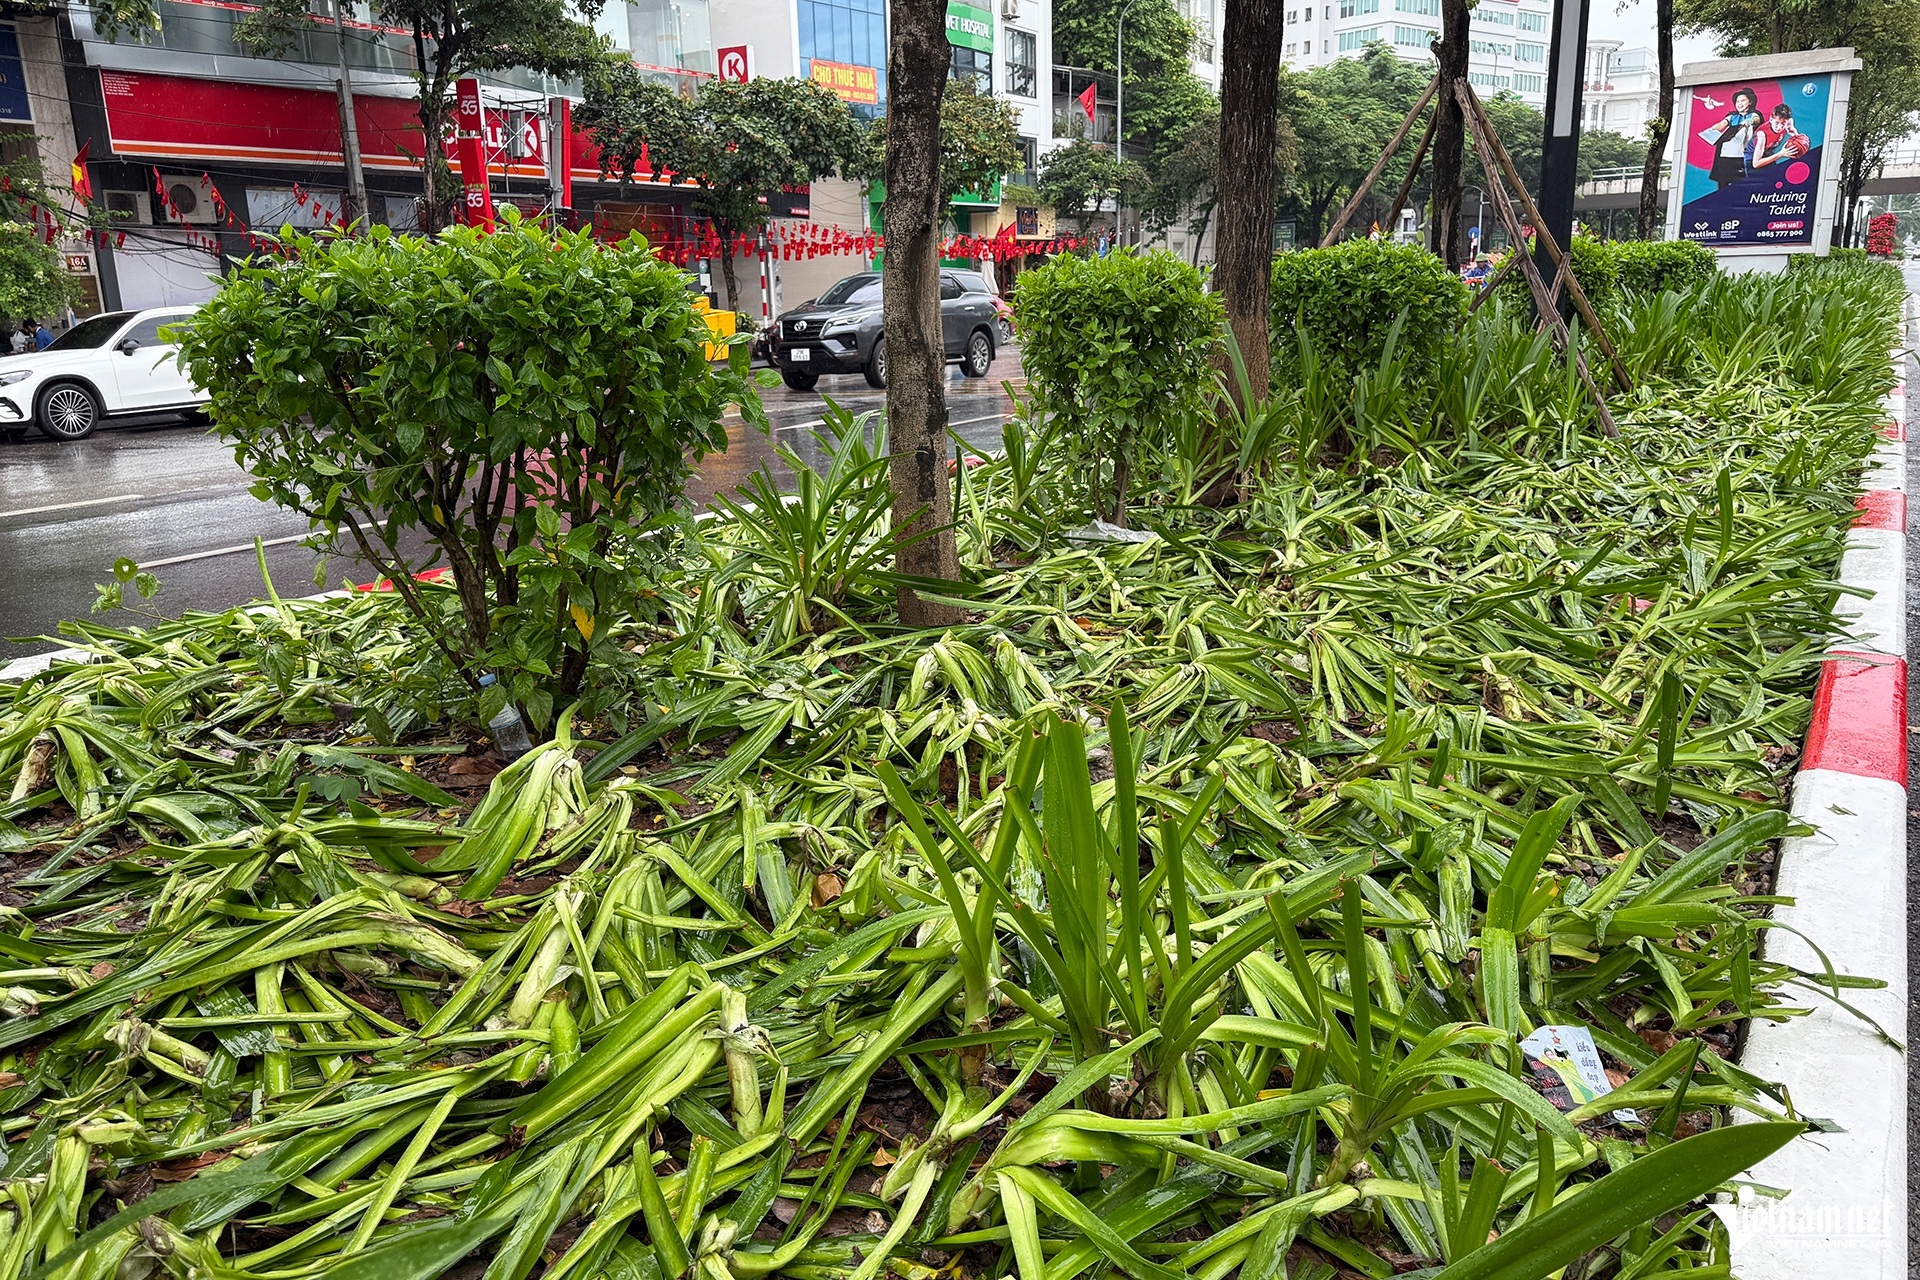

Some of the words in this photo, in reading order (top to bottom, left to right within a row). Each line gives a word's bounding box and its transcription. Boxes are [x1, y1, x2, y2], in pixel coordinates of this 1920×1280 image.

[961, 17, 990, 39] HOSPITAL
[813, 65, 831, 83] CHO
[833, 66, 855, 87] THUÊ
[460, 100, 478, 115] 5G
[467, 193, 484, 207] 5G
[1749, 191, 1808, 204] Nurturing
[1769, 204, 1807, 216] Talent
[1756, 230, 1775, 238] 0865
[70, 257, 87, 267] 16A
